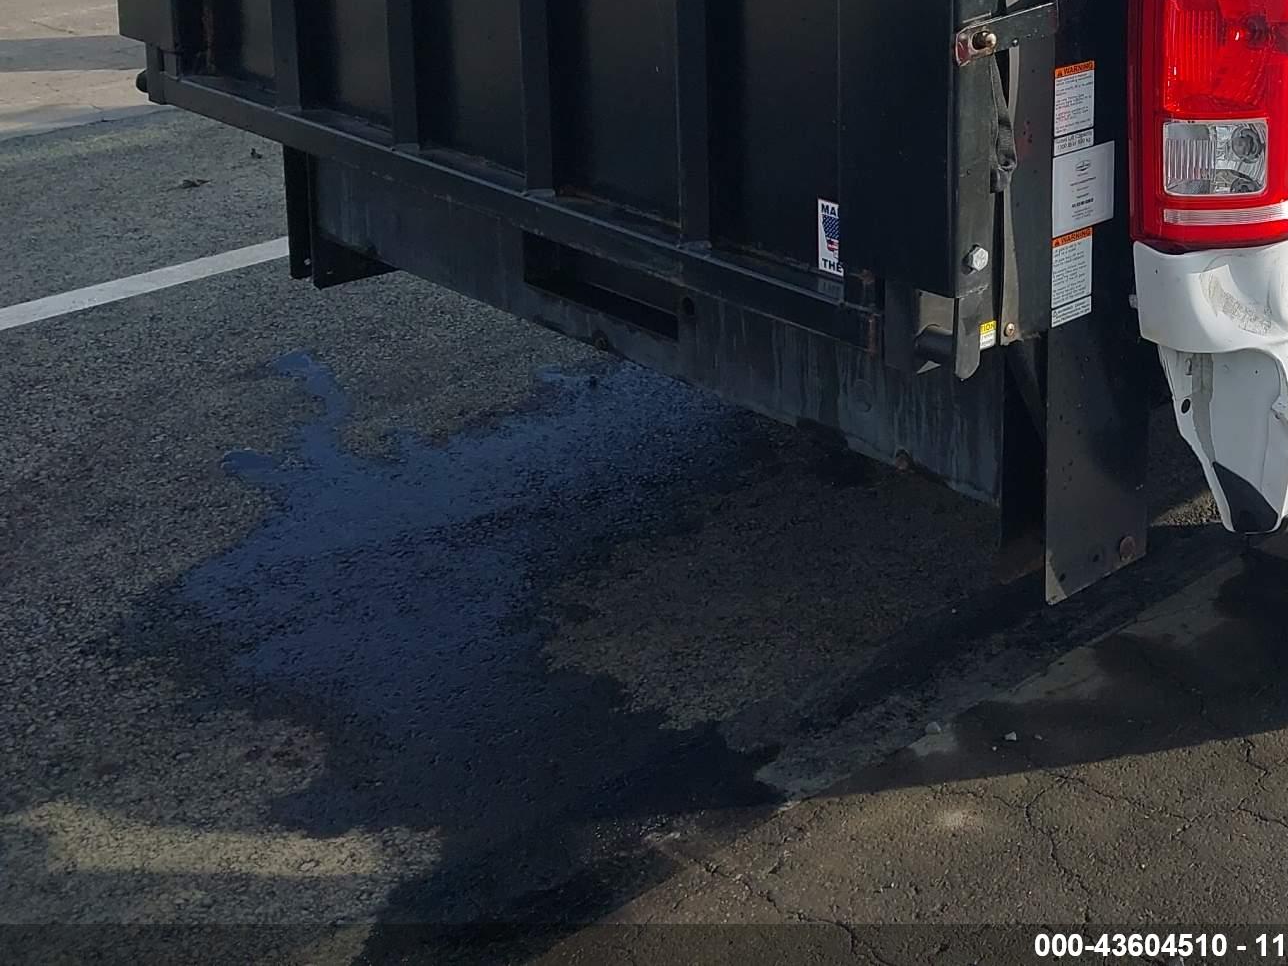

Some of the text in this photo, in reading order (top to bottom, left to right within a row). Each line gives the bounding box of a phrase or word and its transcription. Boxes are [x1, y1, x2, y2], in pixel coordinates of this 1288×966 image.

[1063, 61, 1093, 75] WARNING
[822, 203, 839, 217] MA
[1061, 228, 1091, 244] WARNING
[821, 257, 843, 273] THE
